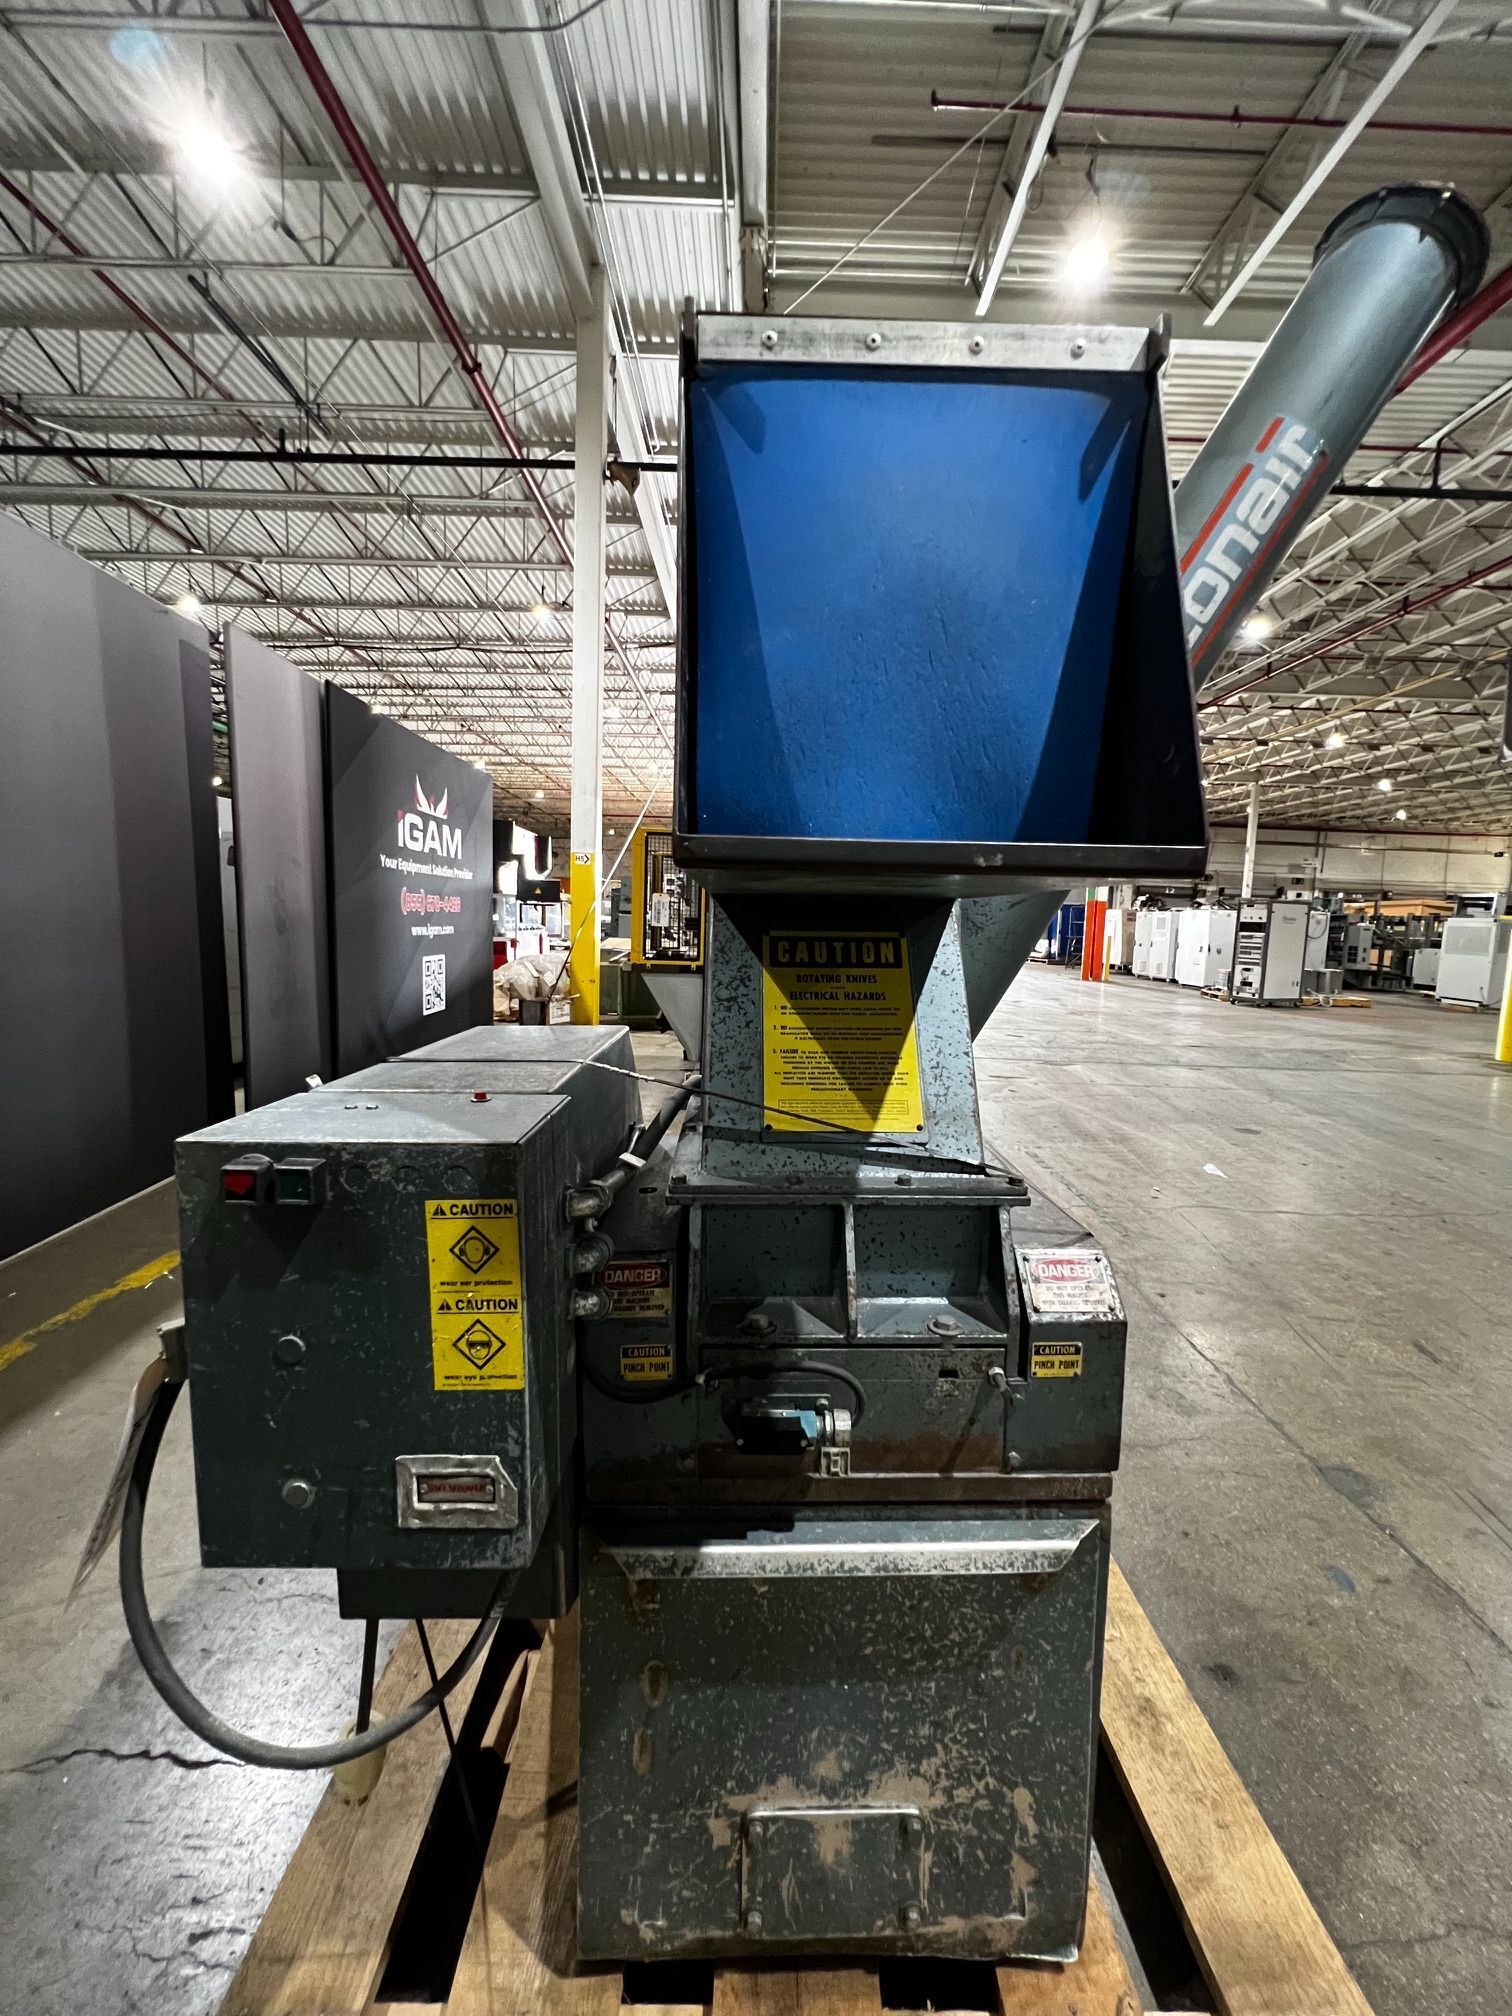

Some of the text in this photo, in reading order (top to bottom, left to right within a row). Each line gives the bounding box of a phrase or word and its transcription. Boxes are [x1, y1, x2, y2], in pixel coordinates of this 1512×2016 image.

[1184, 425, 1311, 649] onair
[380, 854, 474, 880] Your Equipment Solution Provider
[777, 940, 896, 964] CAUTION
[796, 974, 878, 984] ROTATING KNIVES
[789, 991, 887, 1001] ELECTRICAL HAZARDS
[450, 1203, 514, 1217] CAUTION
[604, 1269, 661, 1283] DANGER
[1037, 1264, 1096, 1278] DANGER
[474, 1279, 513, 1287] protection
[455, 1298, 518, 1311] CAUTION
[628, 1347, 665, 1357] CAUTION
[1039, 1345, 1076, 1355] CAUTION
[623, 1361, 670, 1374] PINCH POINT
[1033, 1359, 1080, 1370] PINCH POINT
